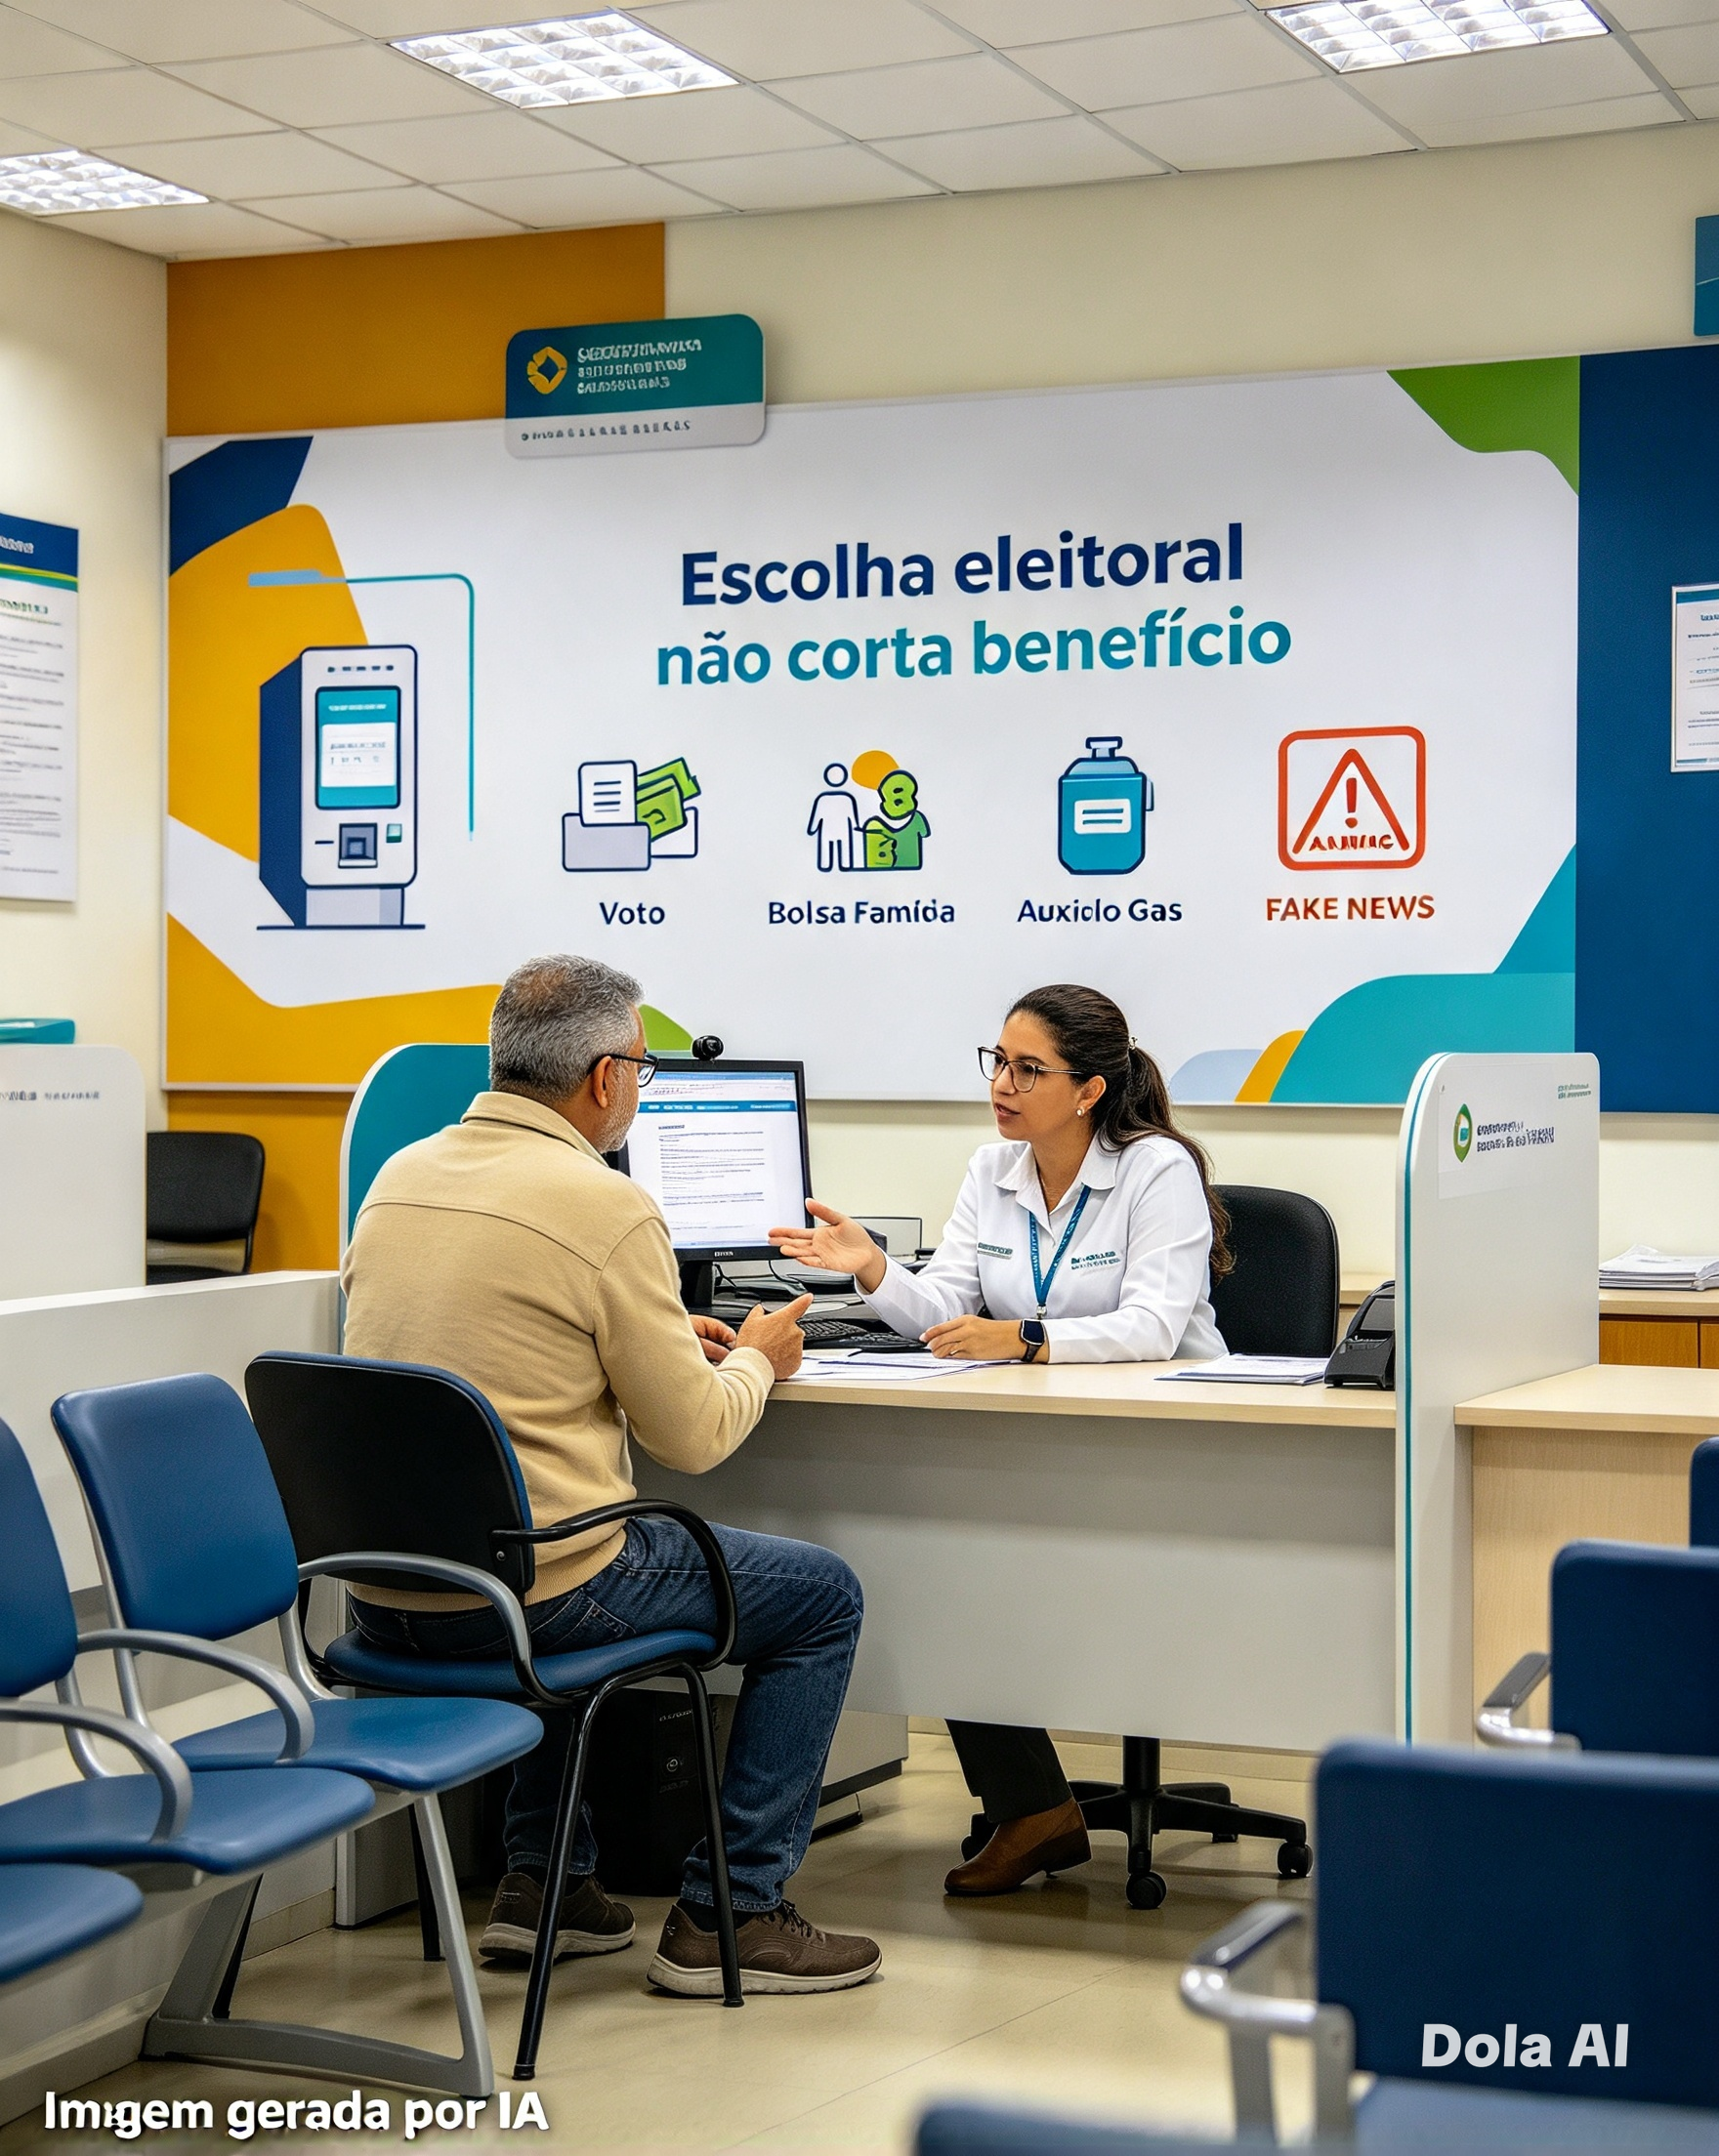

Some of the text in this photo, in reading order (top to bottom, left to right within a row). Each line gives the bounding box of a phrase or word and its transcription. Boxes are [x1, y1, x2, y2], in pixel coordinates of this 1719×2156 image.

[682, 521, 1242, 606] Escolha eleitoral
[657, 604, 1292, 685] não corta benefício
[599, 901, 665, 926] Voto
[769, 900, 846, 925] Bolsa
[1127, 898, 1183, 922] Gas
[1267, 894, 1435, 922] FAKE NEWS
